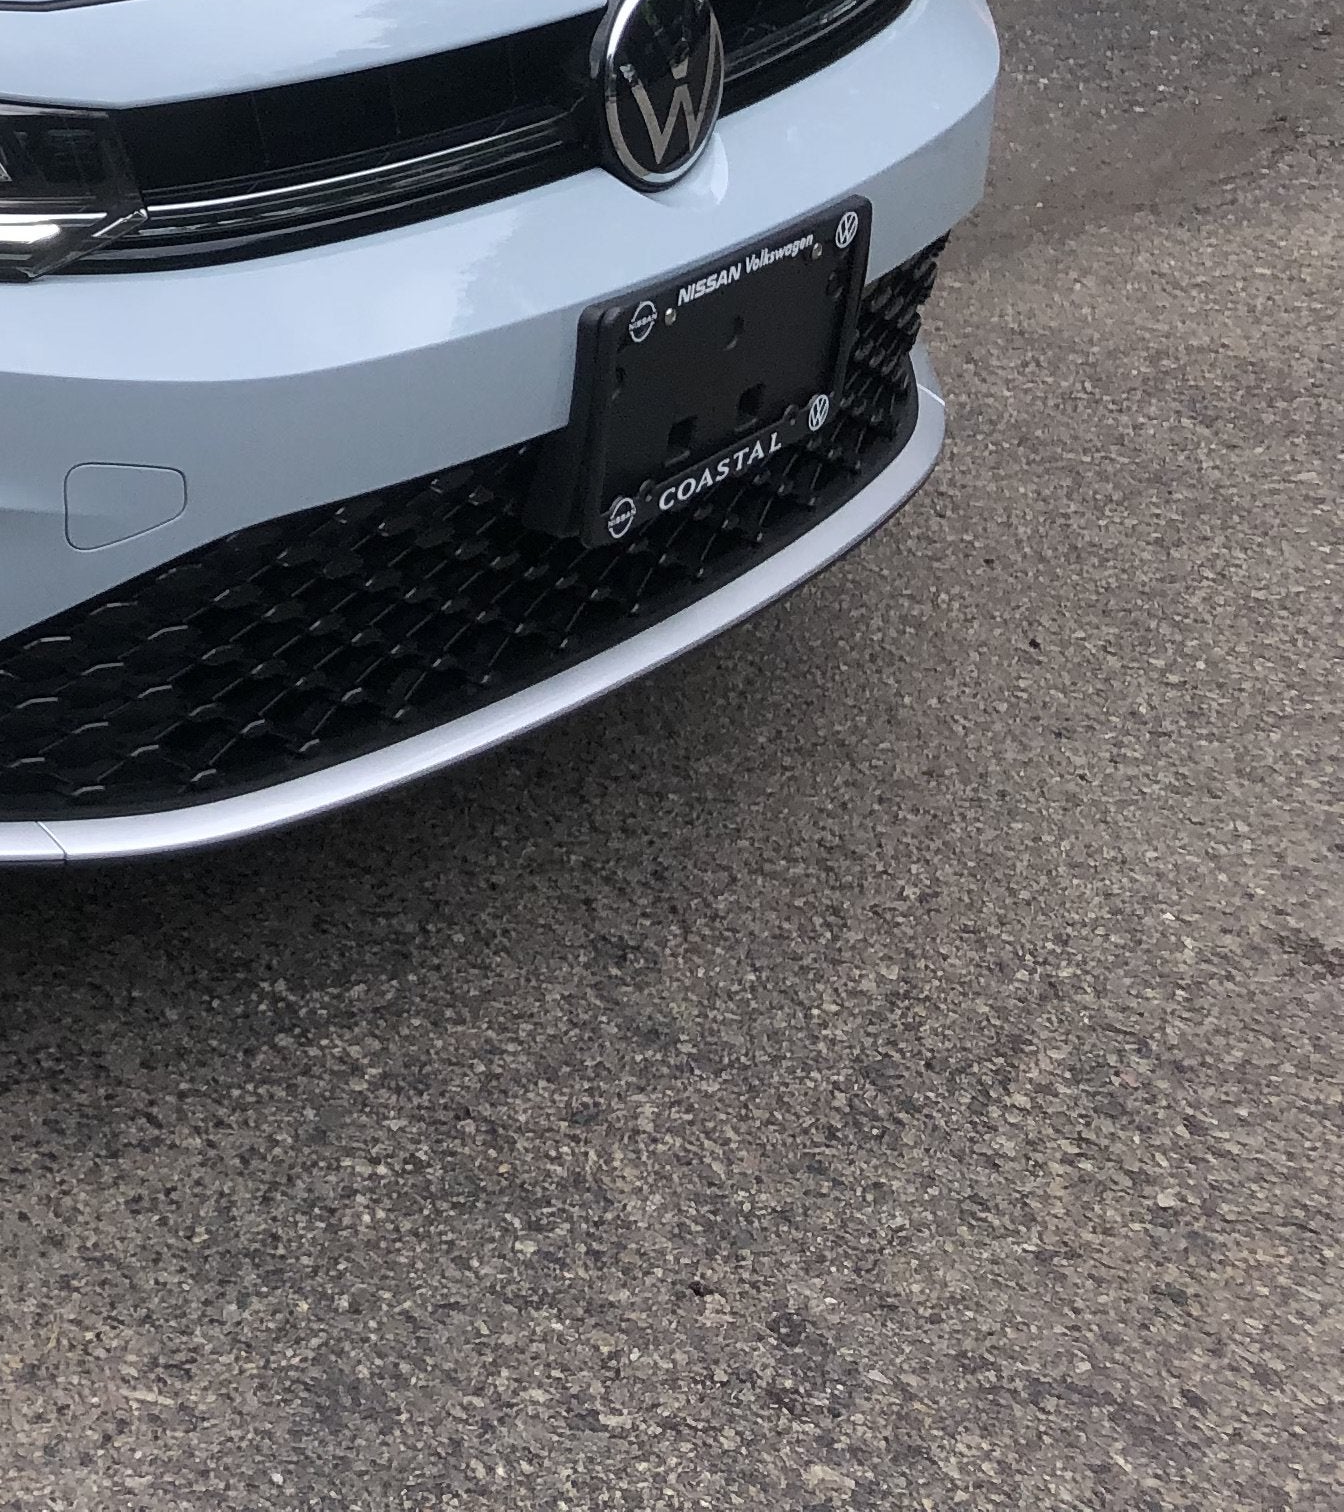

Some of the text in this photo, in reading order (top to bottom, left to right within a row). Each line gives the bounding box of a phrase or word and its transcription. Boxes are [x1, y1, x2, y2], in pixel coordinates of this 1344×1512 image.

[678, 234, 814, 306] NISSAN Volkswagen
[659, 432, 782, 510] COASTAL
